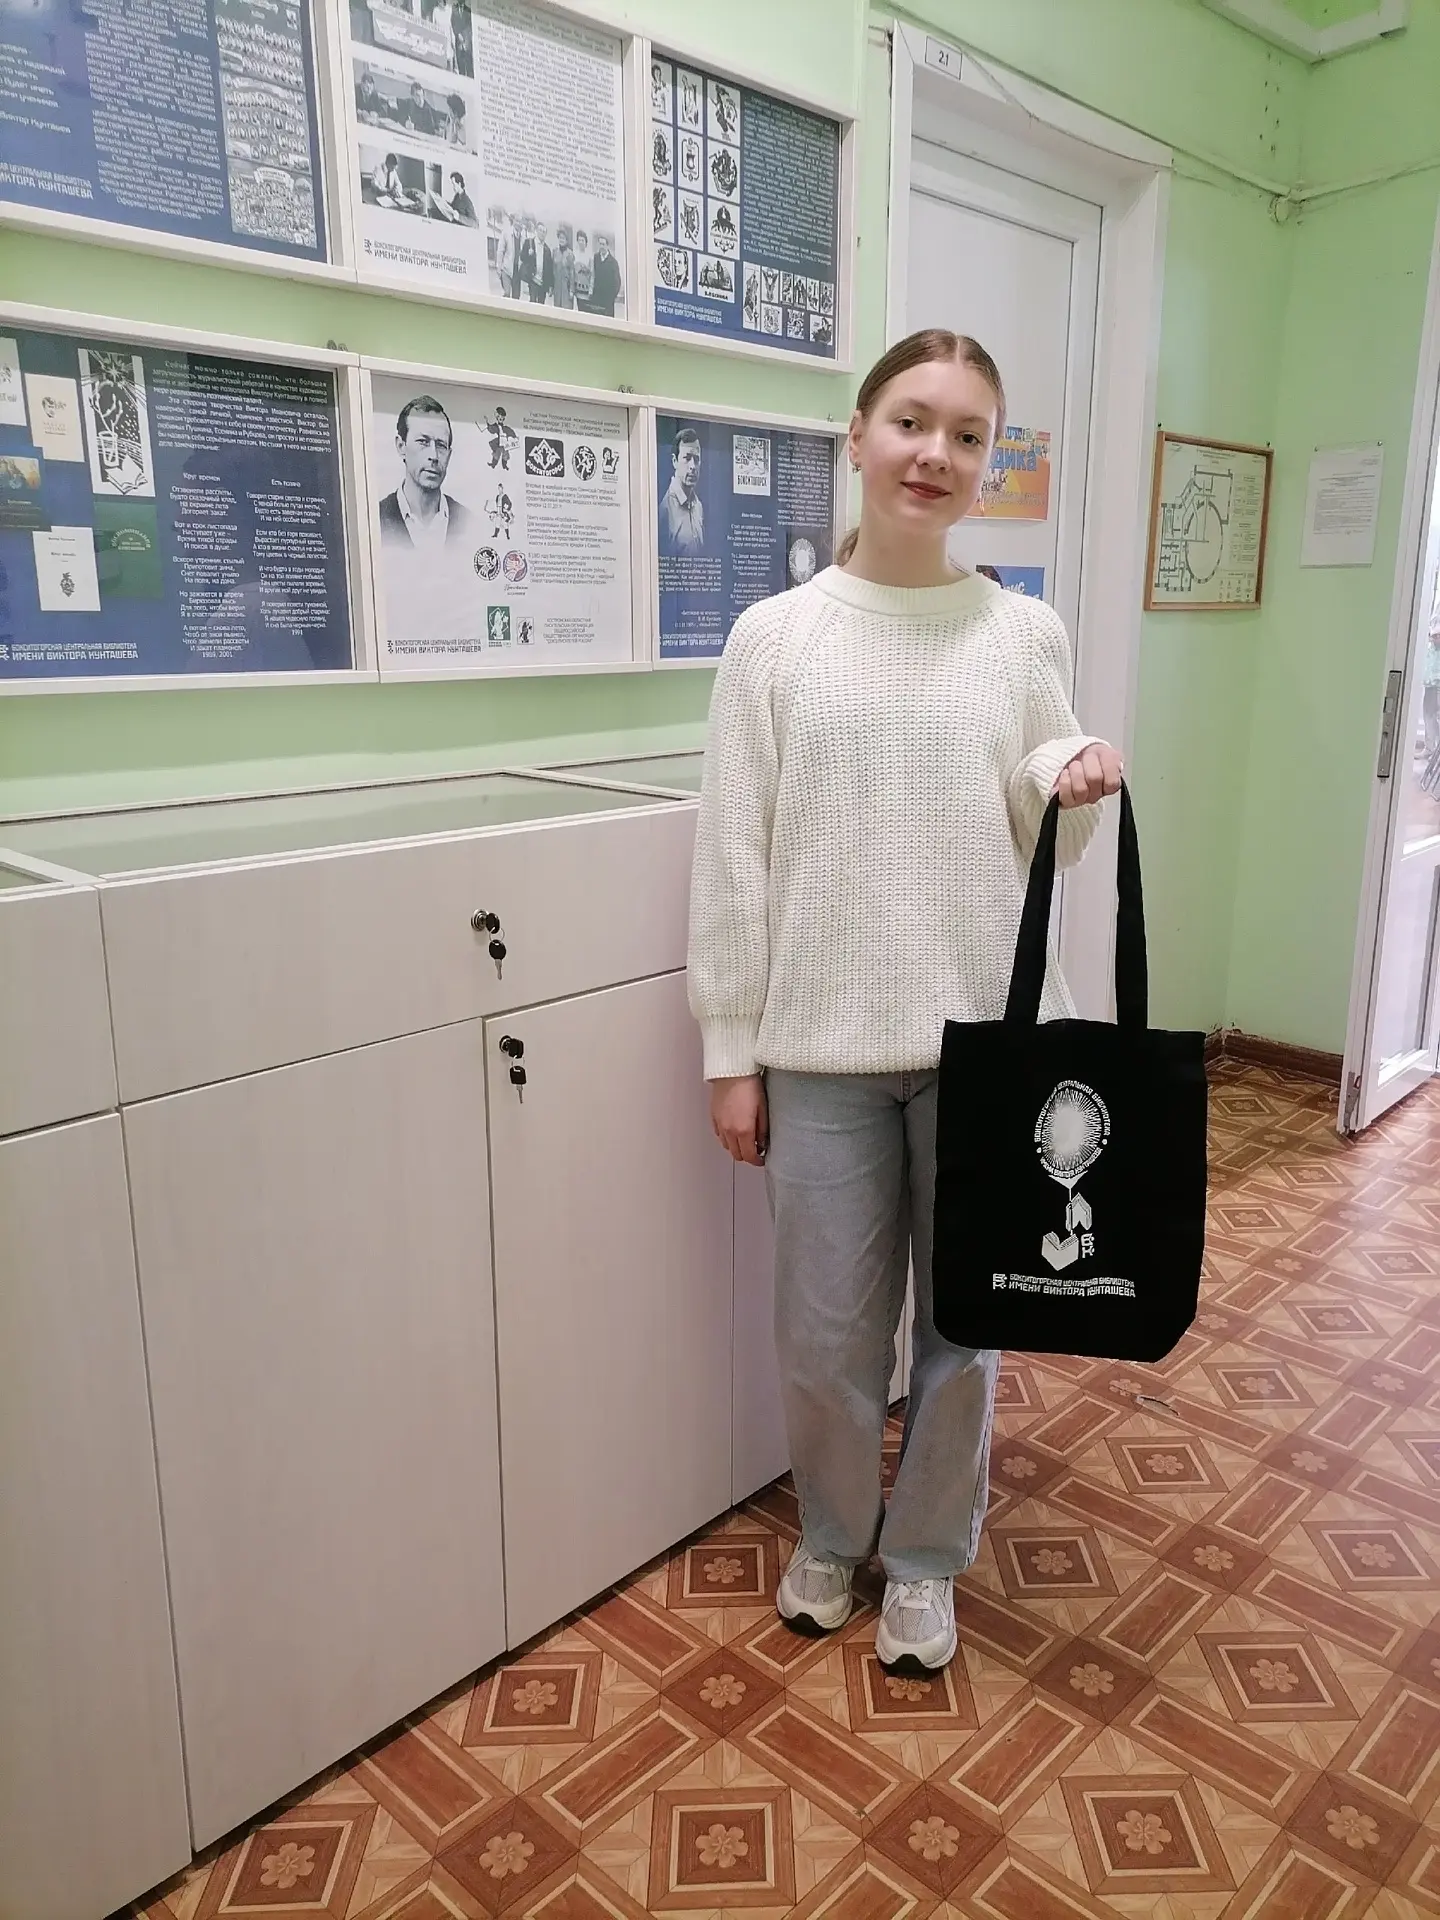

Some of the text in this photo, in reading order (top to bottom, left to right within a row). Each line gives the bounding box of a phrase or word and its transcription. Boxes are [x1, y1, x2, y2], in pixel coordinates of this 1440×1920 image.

[939, 50, 949, 66] 21
[0, 172, 93, 200] ИКТОРА КУНТАШЕВА
[374, 250, 467, 274] ИМЕНИ ВИКТОРА КУНТАШЕВА
[246, 406, 269, 414] Виктора
[298, 419, 316, 428] Виктор
[992, 447, 1037, 473] дика
[183, 472, 197, 480] Круг
[170, 493, 188, 501] Будто
[12, 650, 139, 661] ИМЕНИ ВИКТОРА КУНТАШЕВА
[419, 646, 446, 654] ВИКТОРА
[1092, 1093, 1111, 1136] БИБЛИОТЕКА
[1010, 1274, 1062, 1287] БОКСИТОГОРСКАЯ
[1099, 1277, 1135, 1288] БИБЛИОТЕКА
[1009, 1282, 1041, 1292] ИМЕНИ
[1043, 1286, 1085, 1297] ВИКТОРА
